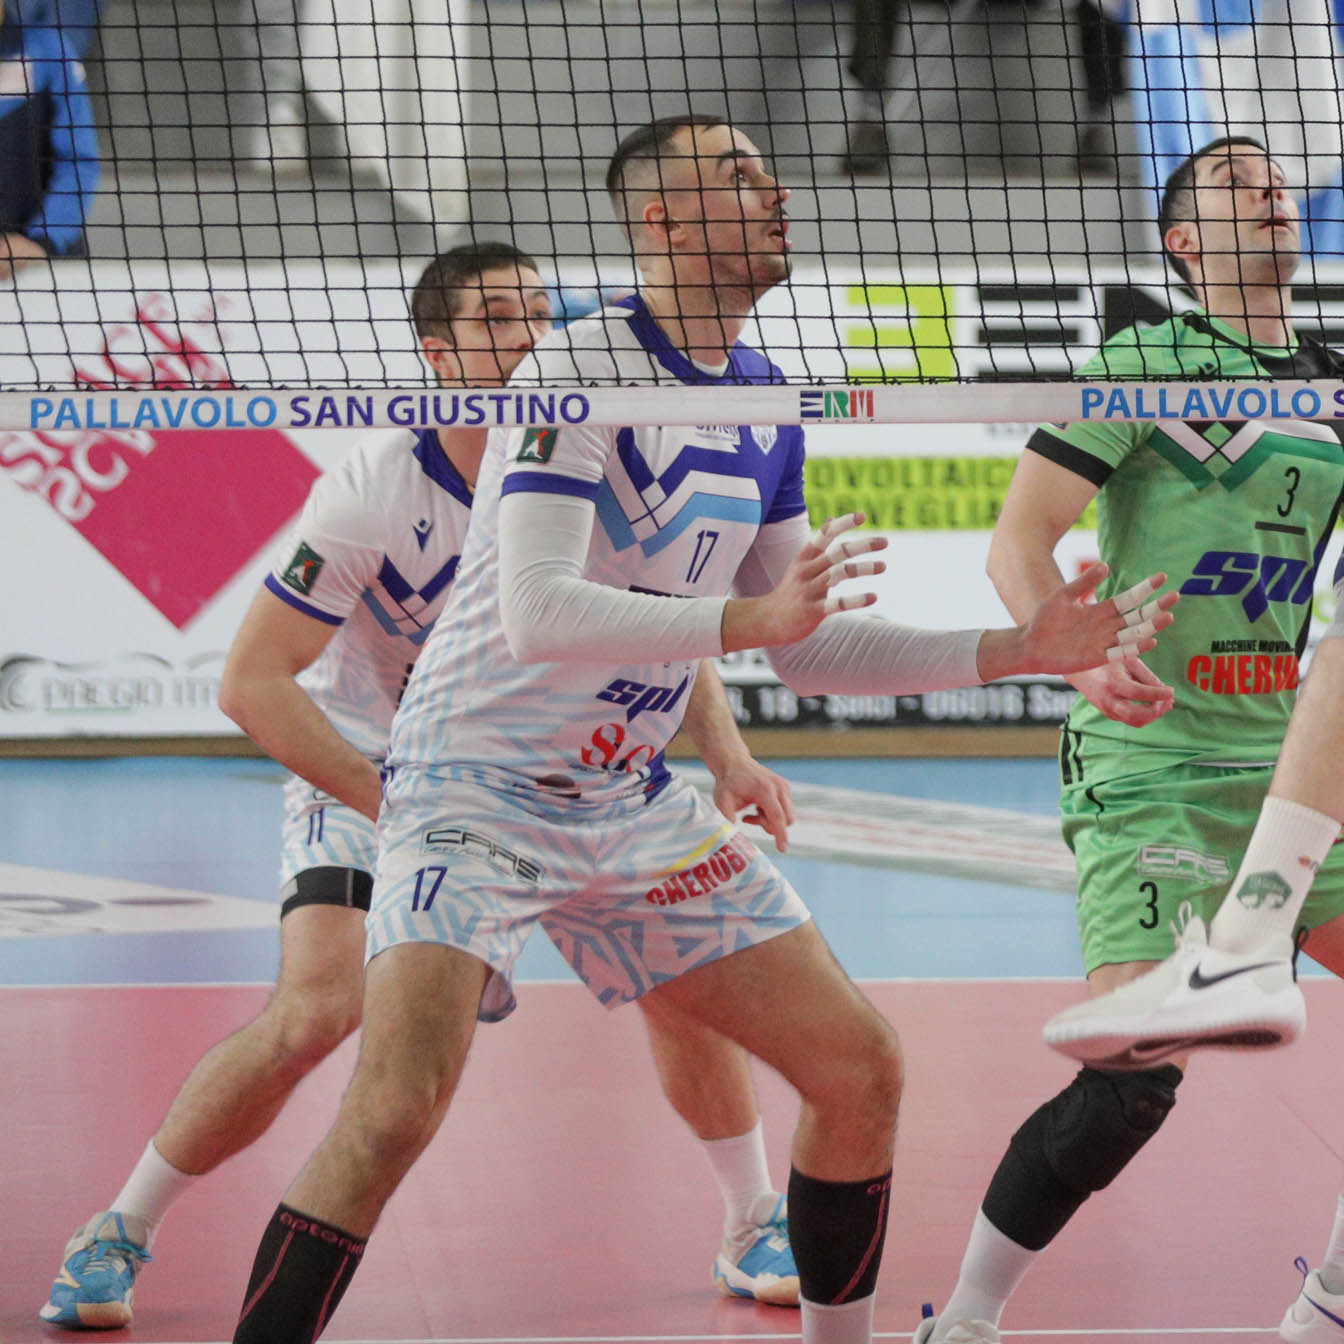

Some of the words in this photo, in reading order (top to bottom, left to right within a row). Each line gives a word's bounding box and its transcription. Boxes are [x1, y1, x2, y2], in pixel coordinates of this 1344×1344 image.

[30, 395, 278, 429] PALLAVOLO
[290, 395, 374, 427] SAN
[387, 392, 590, 426] GIUSTINO
[1081, 388, 1321, 419] PALLAVOLO
[1276, 466, 1301, 518] 3
[684, 529, 720, 584] 17
[410, 866, 448, 913] 17
[1138, 881, 1160, 930] 3
